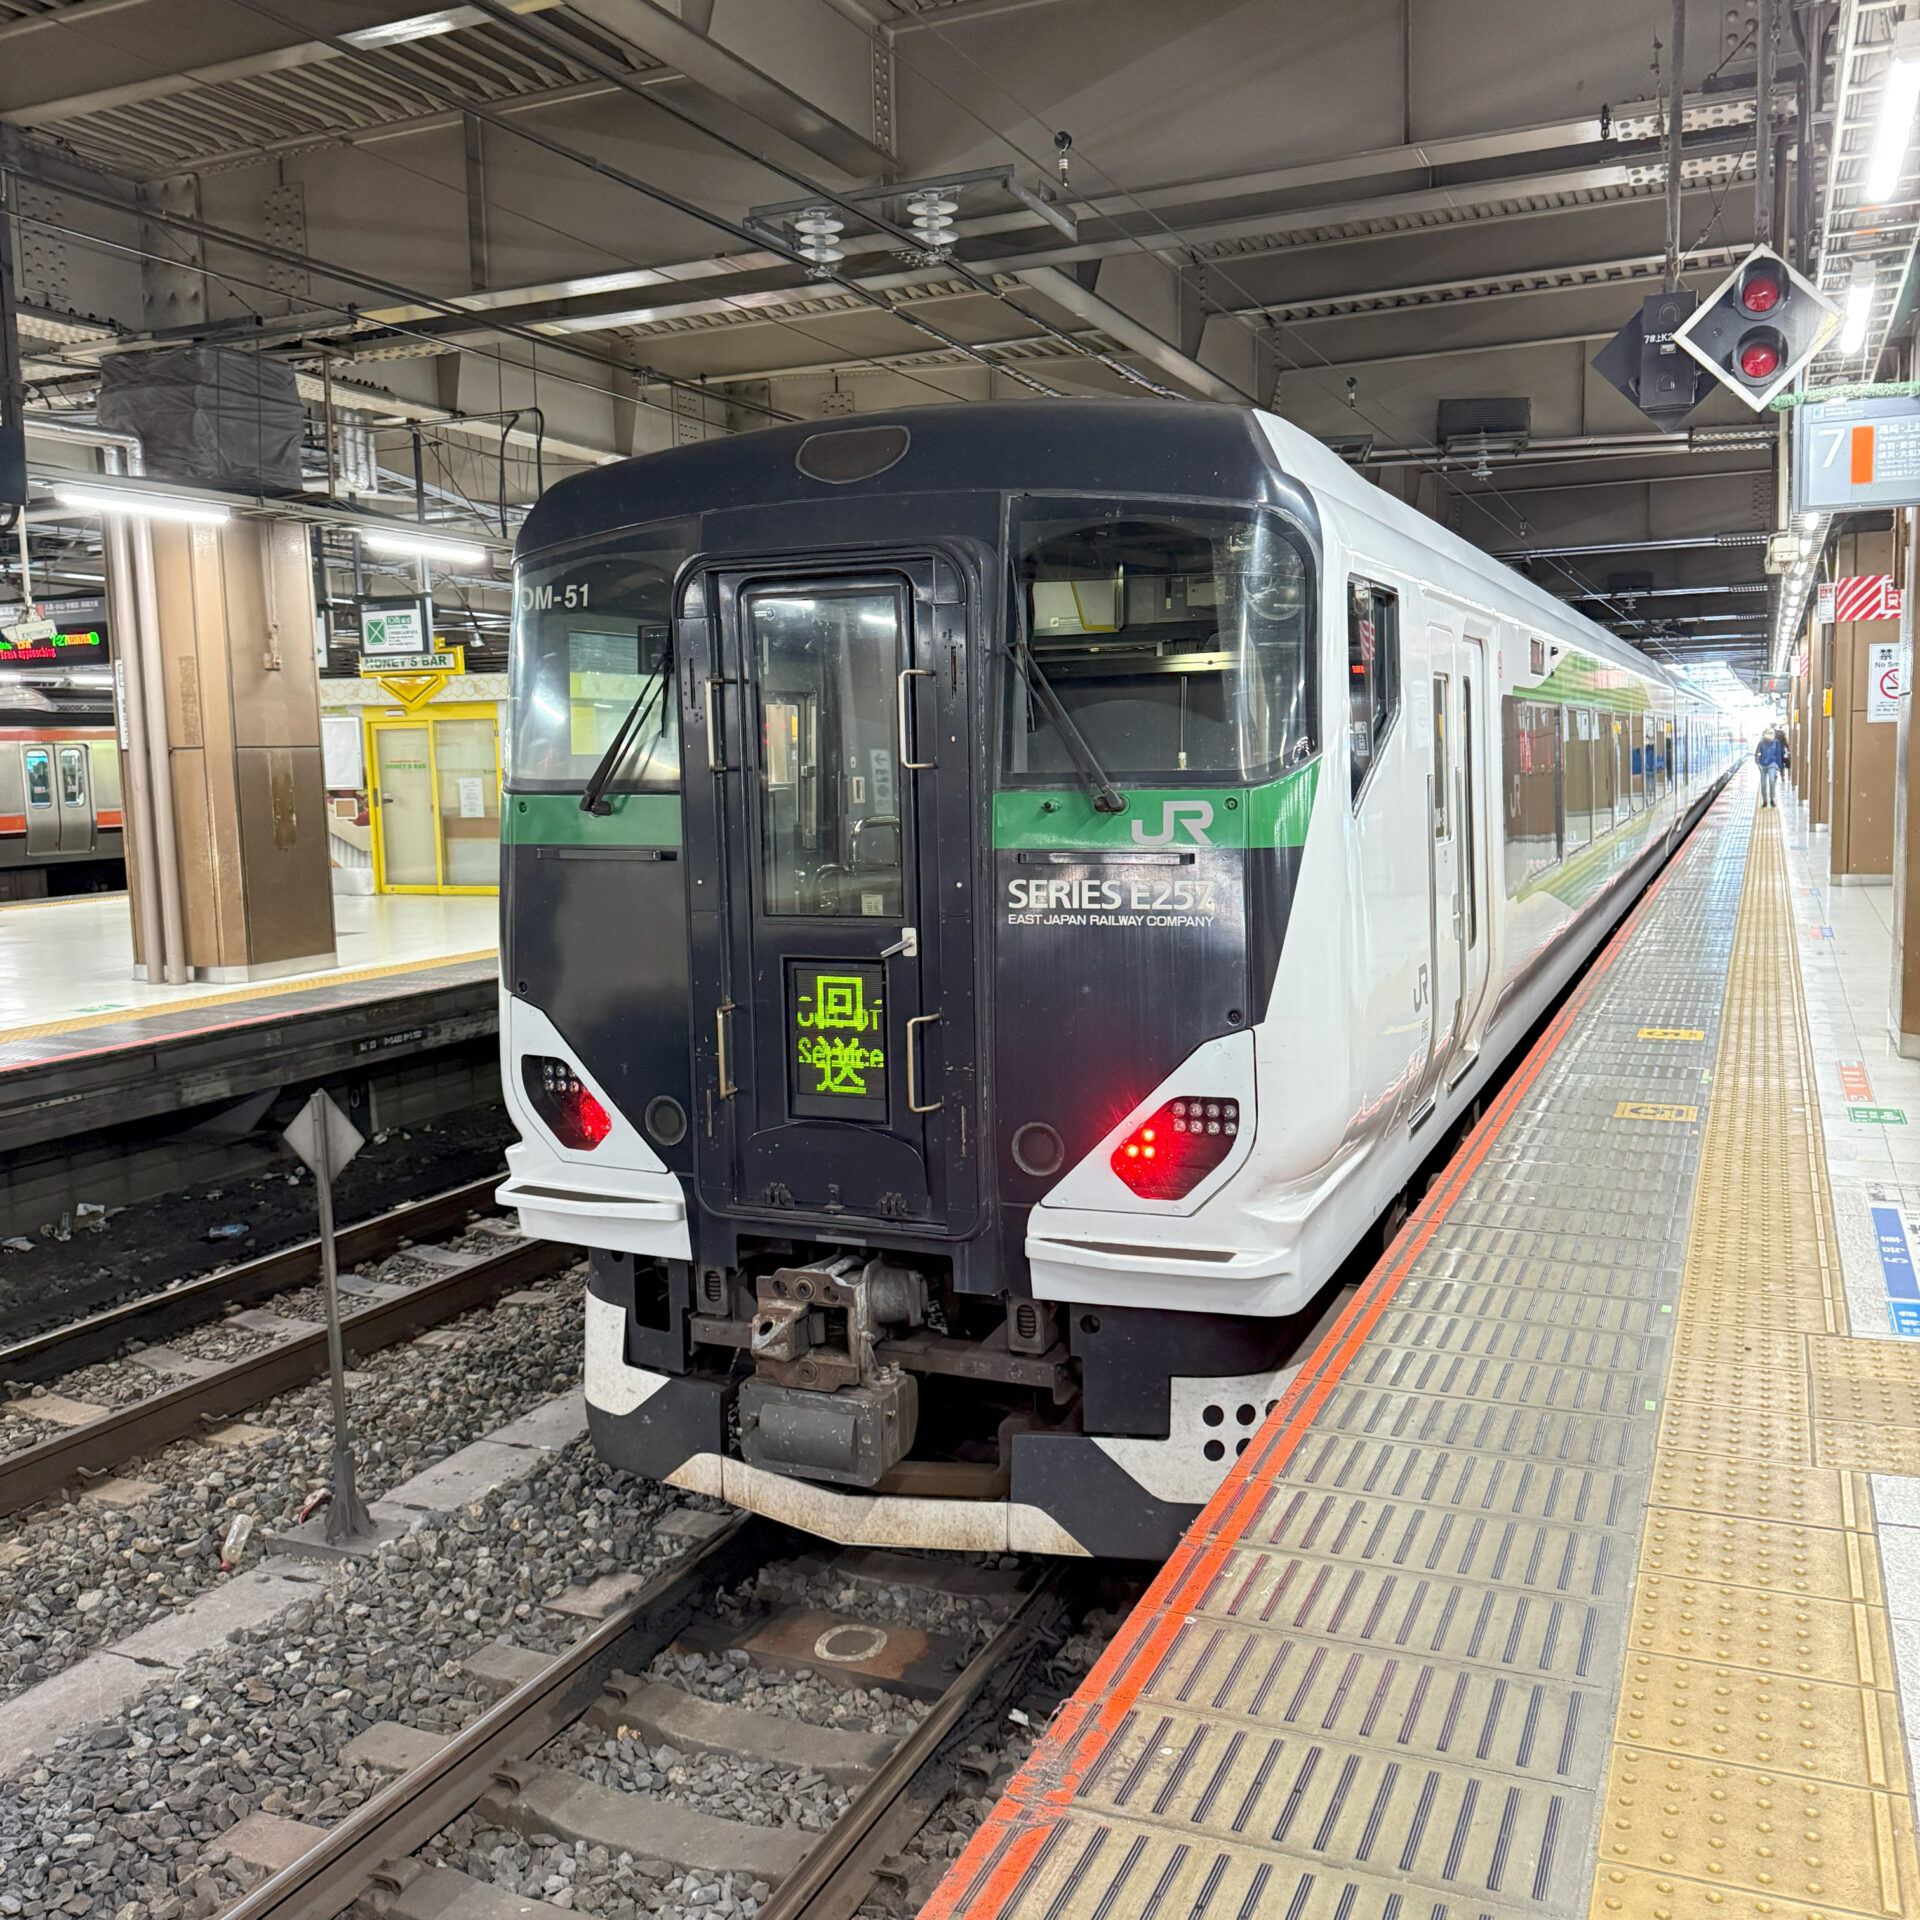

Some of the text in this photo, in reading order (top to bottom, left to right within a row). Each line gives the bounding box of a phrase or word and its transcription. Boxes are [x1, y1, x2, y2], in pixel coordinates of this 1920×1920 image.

[1818, 427, 1846, 468] 7
[422, 655, 447, 667] BAR
[1131, 800, 1214, 846] JR
[1008, 878, 1215, 910] SERIES E257
[1008, 914, 1215, 927] EAST JAPAN RAILWAY COMPANY
[1413, 963, 1428, 1013] JR
